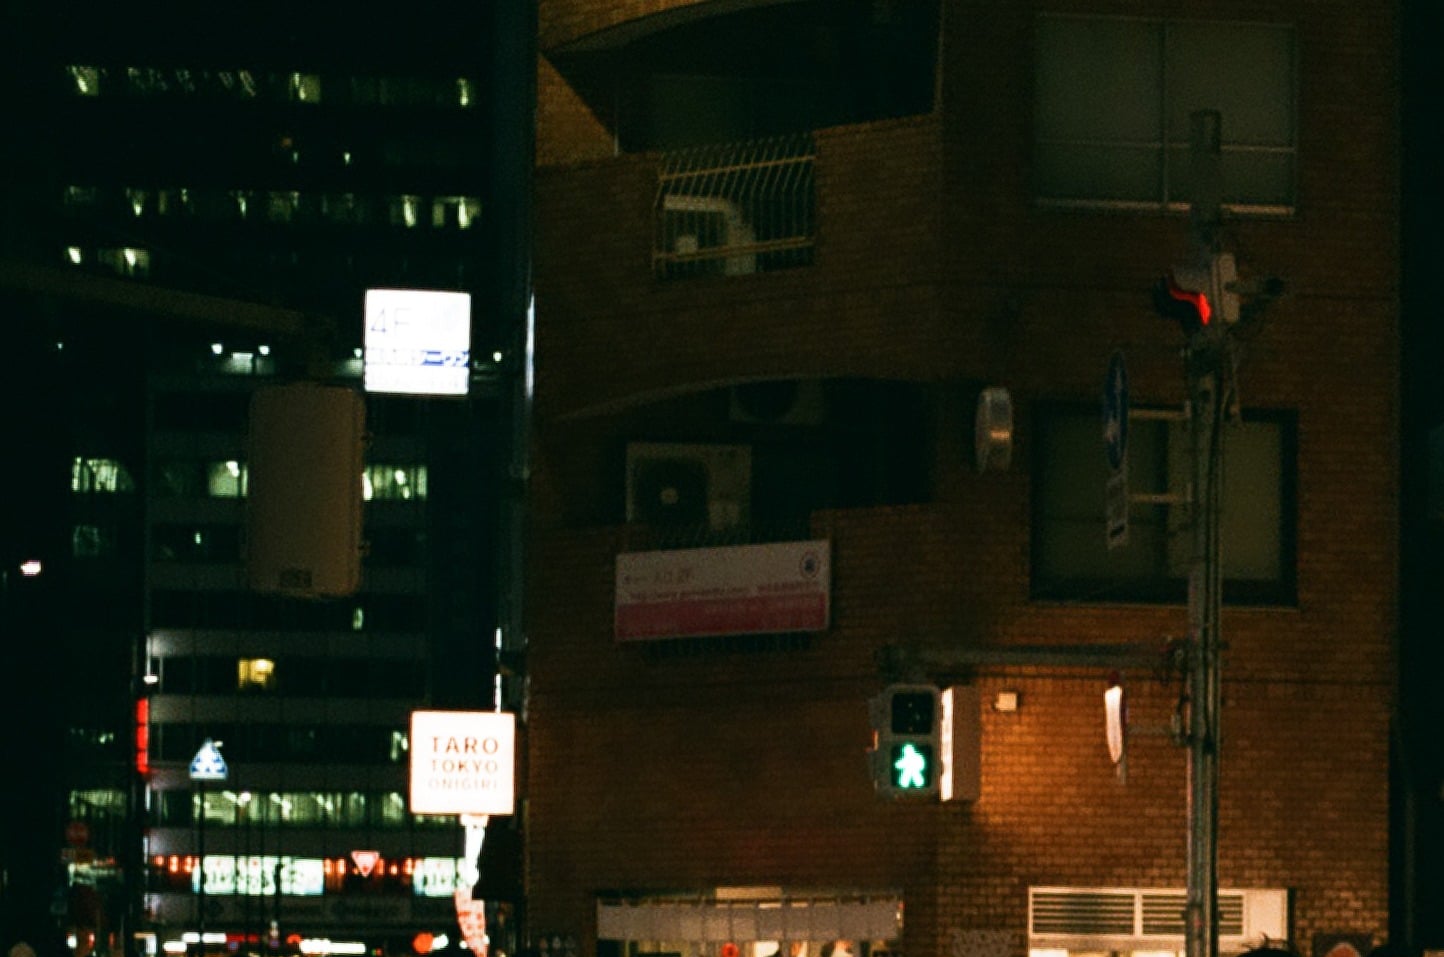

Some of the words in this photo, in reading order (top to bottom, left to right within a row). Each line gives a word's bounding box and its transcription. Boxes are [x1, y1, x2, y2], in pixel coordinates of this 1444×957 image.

[431, 735, 499, 755] TARO
[431, 759, 498, 774] TOKYO
[428, 777, 498, 791] ONIGIRI
